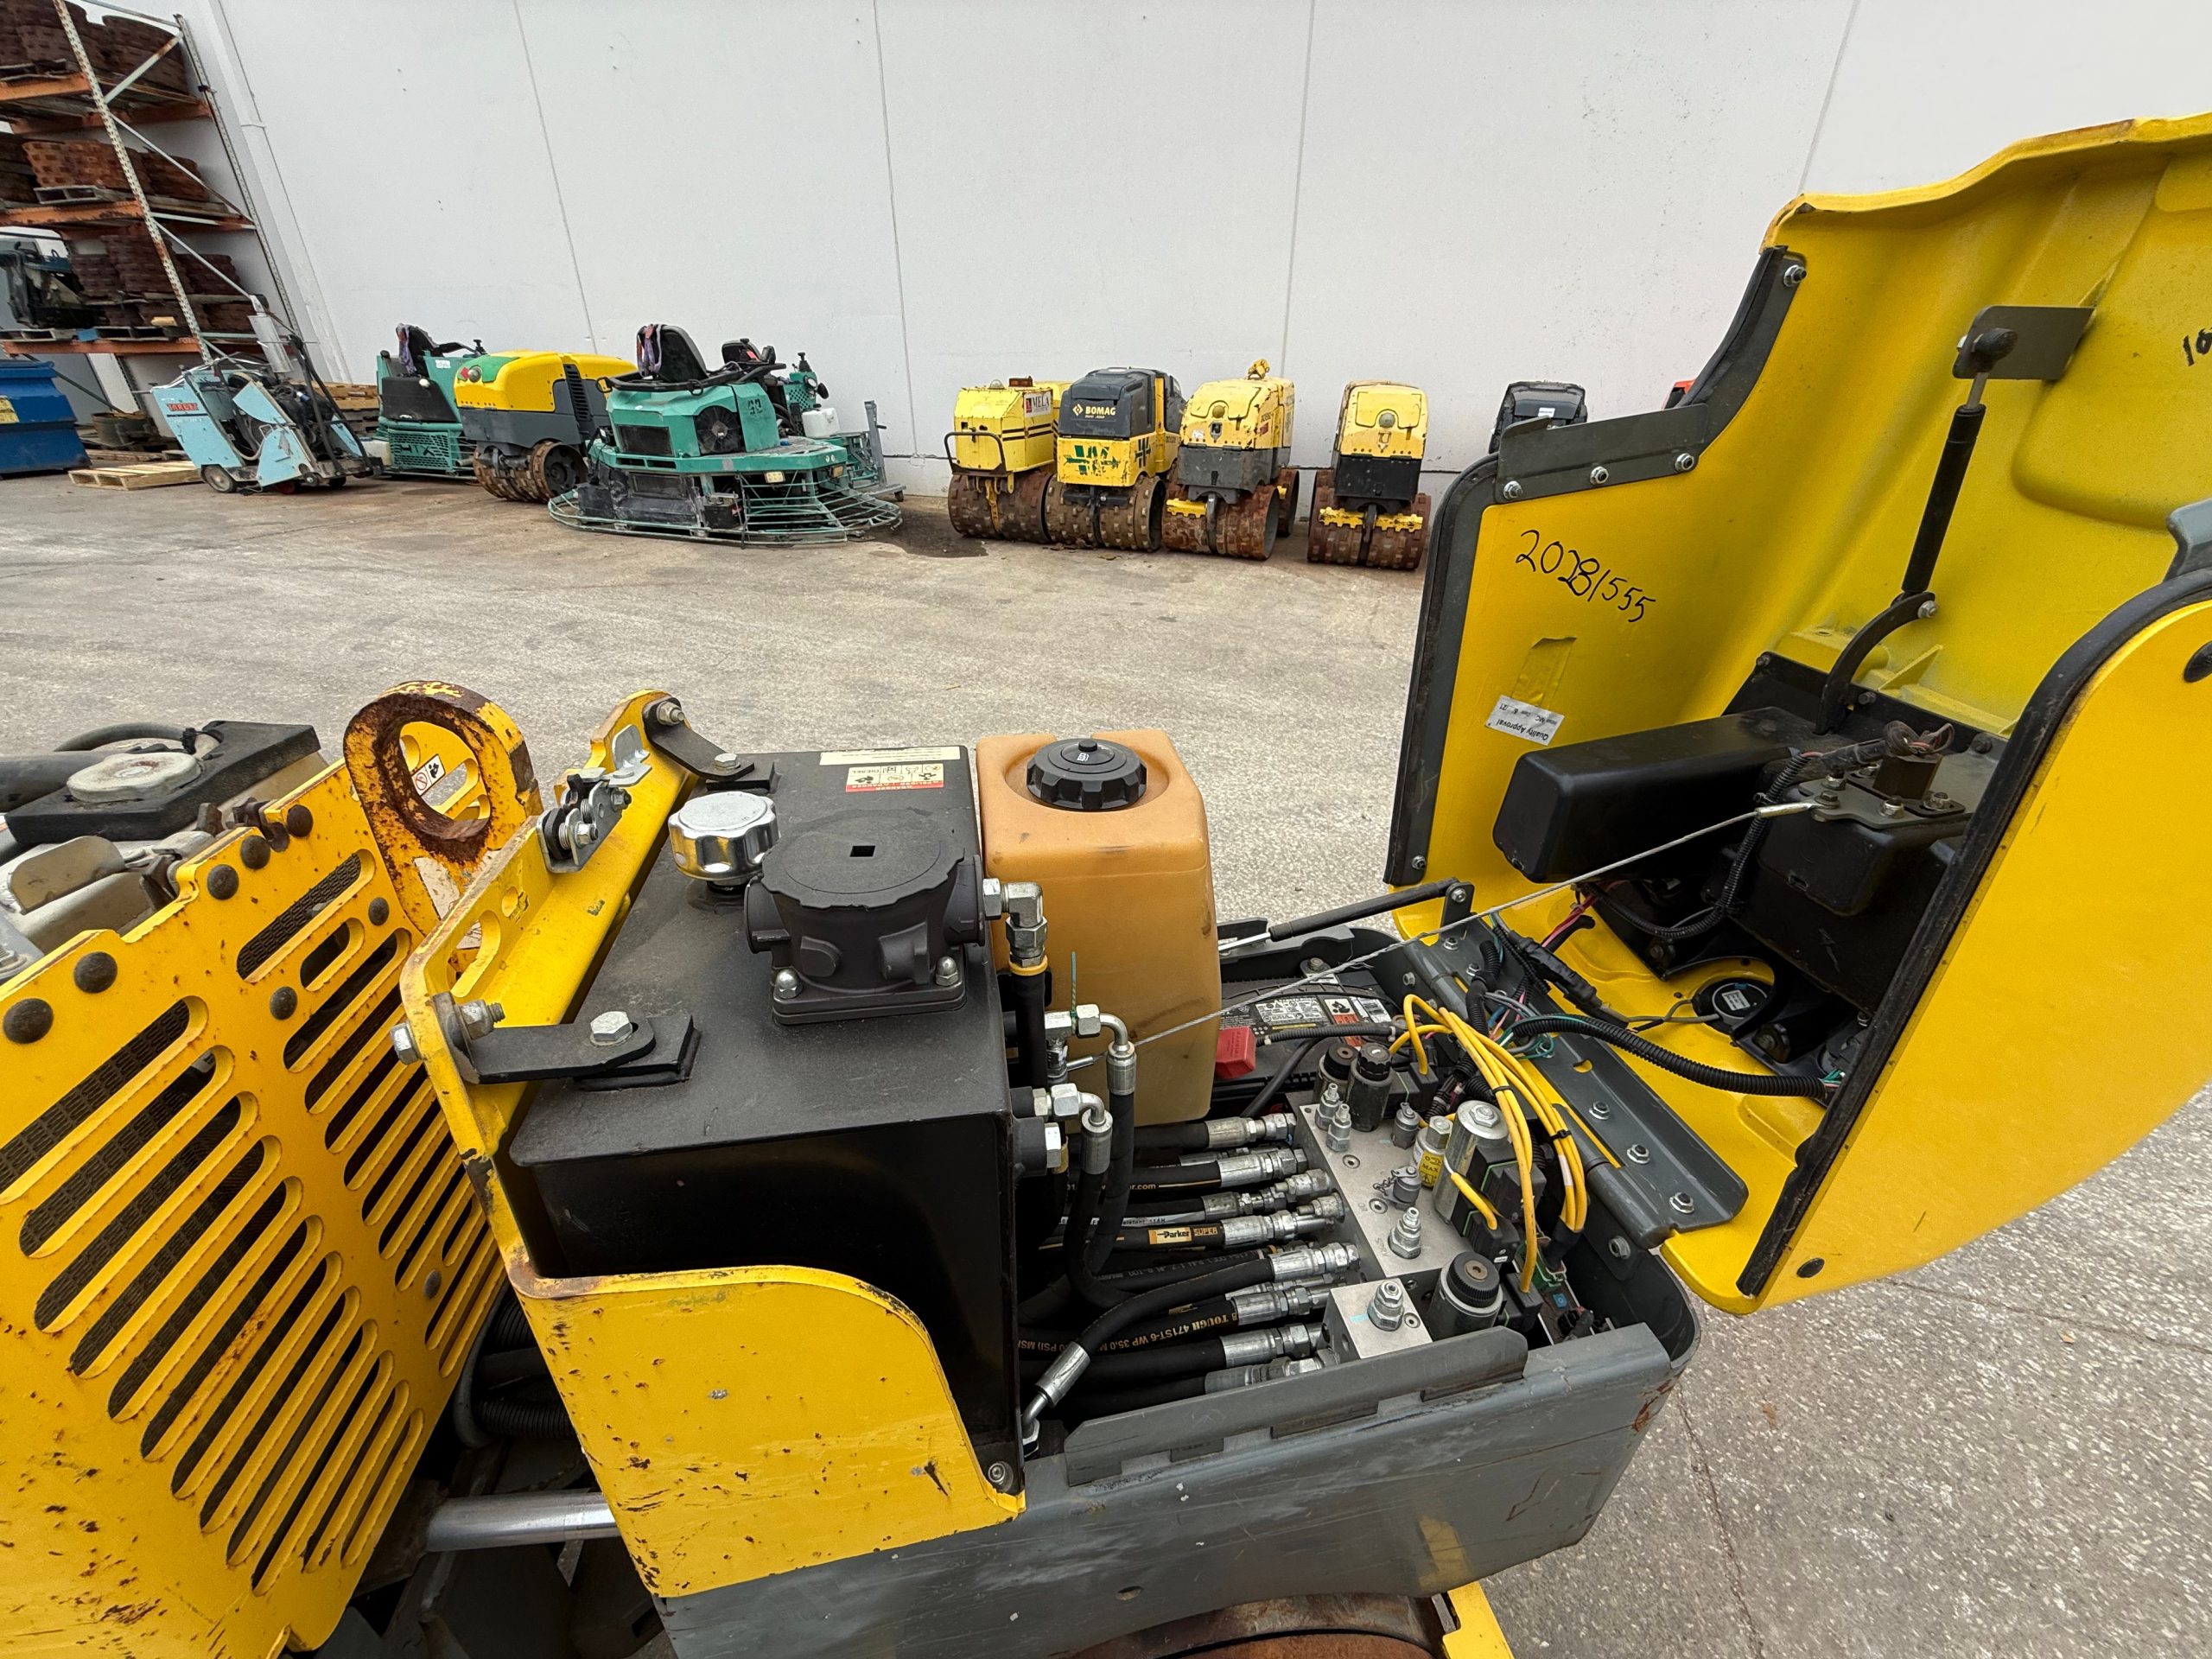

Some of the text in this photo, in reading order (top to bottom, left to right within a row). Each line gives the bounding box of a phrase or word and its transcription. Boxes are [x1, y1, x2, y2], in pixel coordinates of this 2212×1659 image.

[1084, 406, 1116, 416] BOMAG
[1496, 718, 1549, 741] Quality Approval
[1421, 1162, 1440, 1173] MAX
[1163, 1229, 1190, 1239] Parker
[1191, 1314, 1230, 1332] TOUGH
[1150, 1325, 1190, 1342] 471ST-6
[1132, 1335, 1149, 1346] WP
[1037, 1342, 1057, 1351] PSI)
